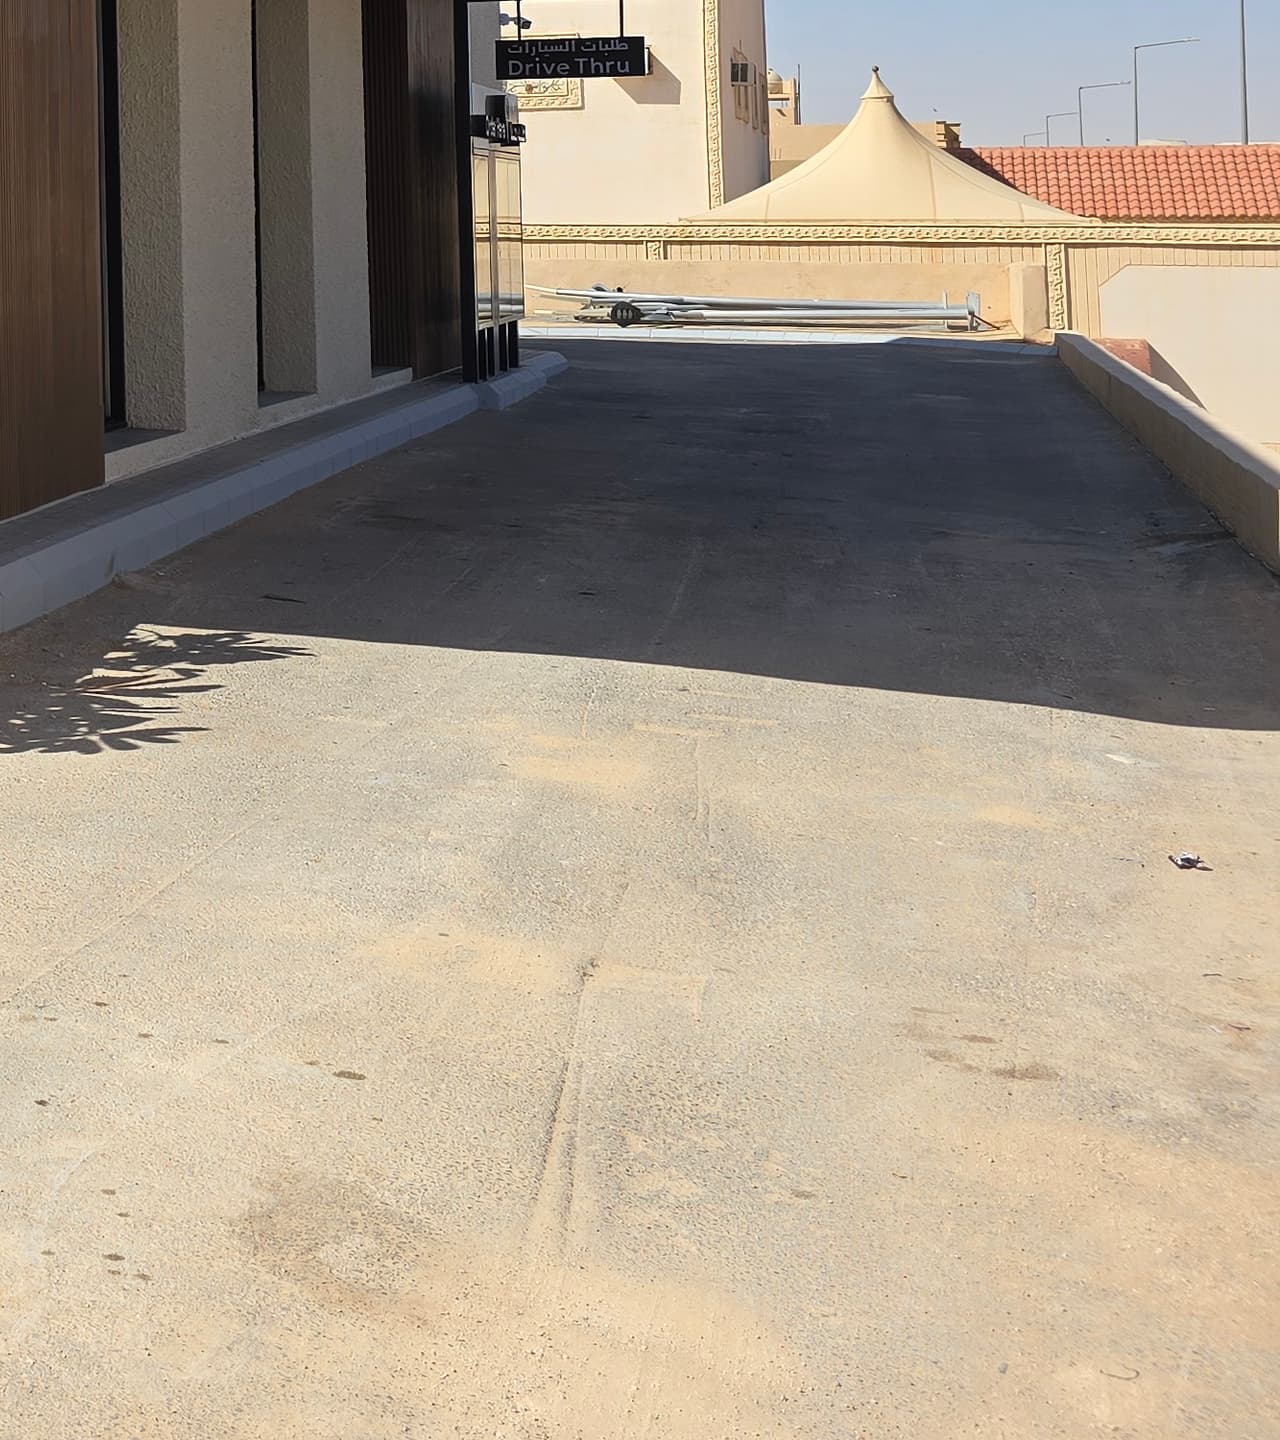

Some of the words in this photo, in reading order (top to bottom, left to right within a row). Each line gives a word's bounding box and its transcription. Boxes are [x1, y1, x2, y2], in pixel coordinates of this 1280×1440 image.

[507, 40, 576, 57] السيارات
[579, 40, 629, 56] طلبات
[508, 57, 570, 76] Drive
[574, 56, 630, 75] Thru
